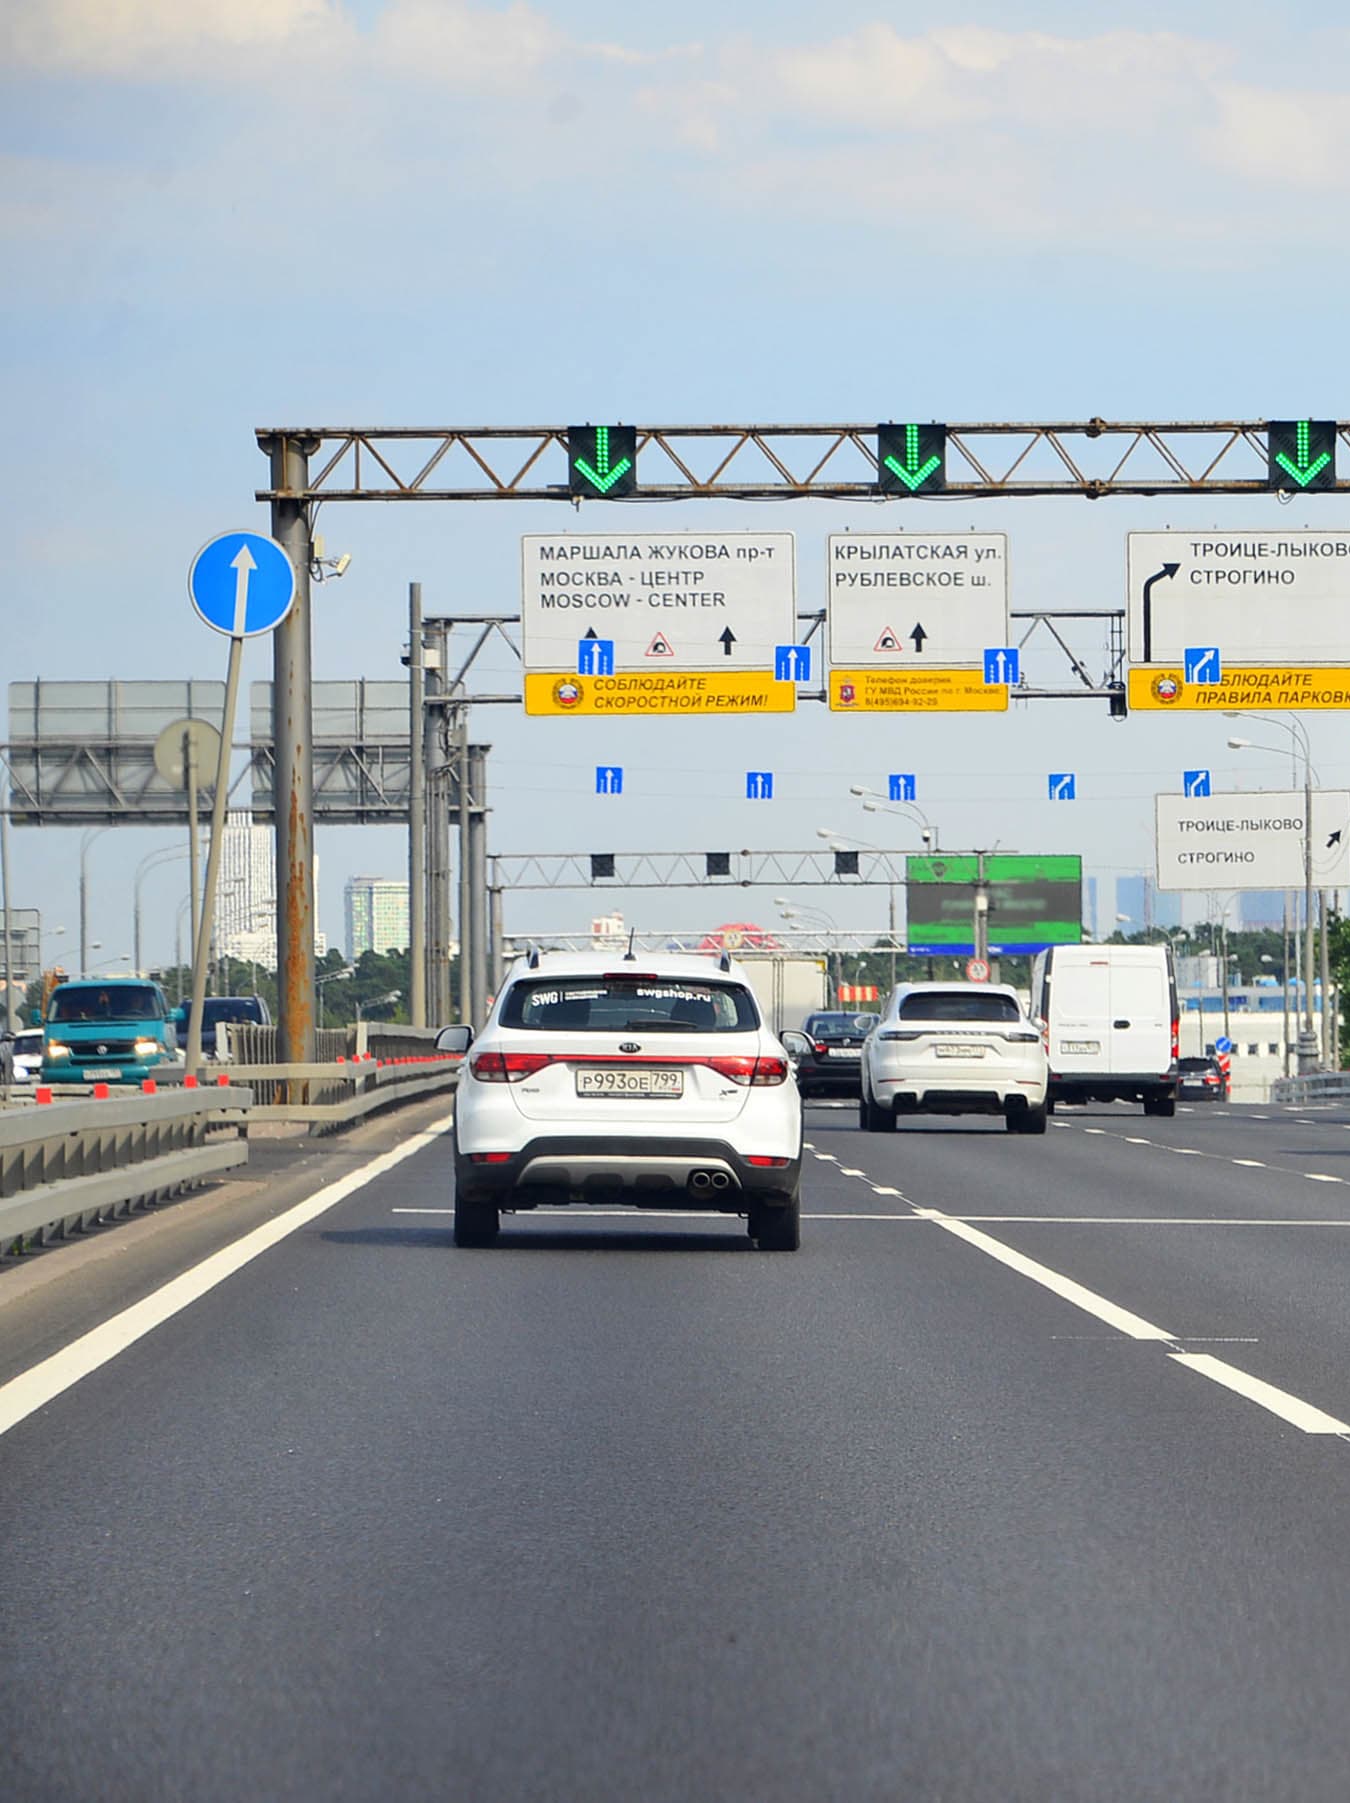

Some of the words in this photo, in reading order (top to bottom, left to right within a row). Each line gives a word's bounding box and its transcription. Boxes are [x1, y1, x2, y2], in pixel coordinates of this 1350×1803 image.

[540, 545, 642, 561] МАРШАЛА
[648, 545, 731, 560] ЖУКОВА
[736, 547, 775, 562] пр-т
[835, 545, 968, 560] КРЫЛАТСКАЯ
[974, 547, 1002, 563] ул.
[540, 571, 623, 586] МОСКВА
[641, 571, 705, 588] ЦЕНТР
[835, 572, 965, 587] РУБЛЕВСКОЕ
[971, 575, 991, 587] ш.
[1190, 569, 1295, 585] СТРОГИНО
[540, 593, 630, 608] MOSCOW
[648, 592, 726, 608] CENTER
[594, 677, 707, 692] СОБЛЮДАЙТЕ
[1197, 671, 1313, 689] БЛЮДАЙТЕ
[594, 693, 702, 709] СКОРОСТНОЙ
[705, 694, 768, 708] РЕЖИМ!
[1196, 691, 1273, 704] ПРАВИЛА
[1178, 818, 1304, 833] ТРОИЦЕ-ЛЫКОВО
[1178, 852, 1255, 864] СТРОГИНО
[532, 991, 559, 1007] SWG
[636, 988, 712, 1002] swgshop.ru
[652, 1072, 678, 1086] 799
